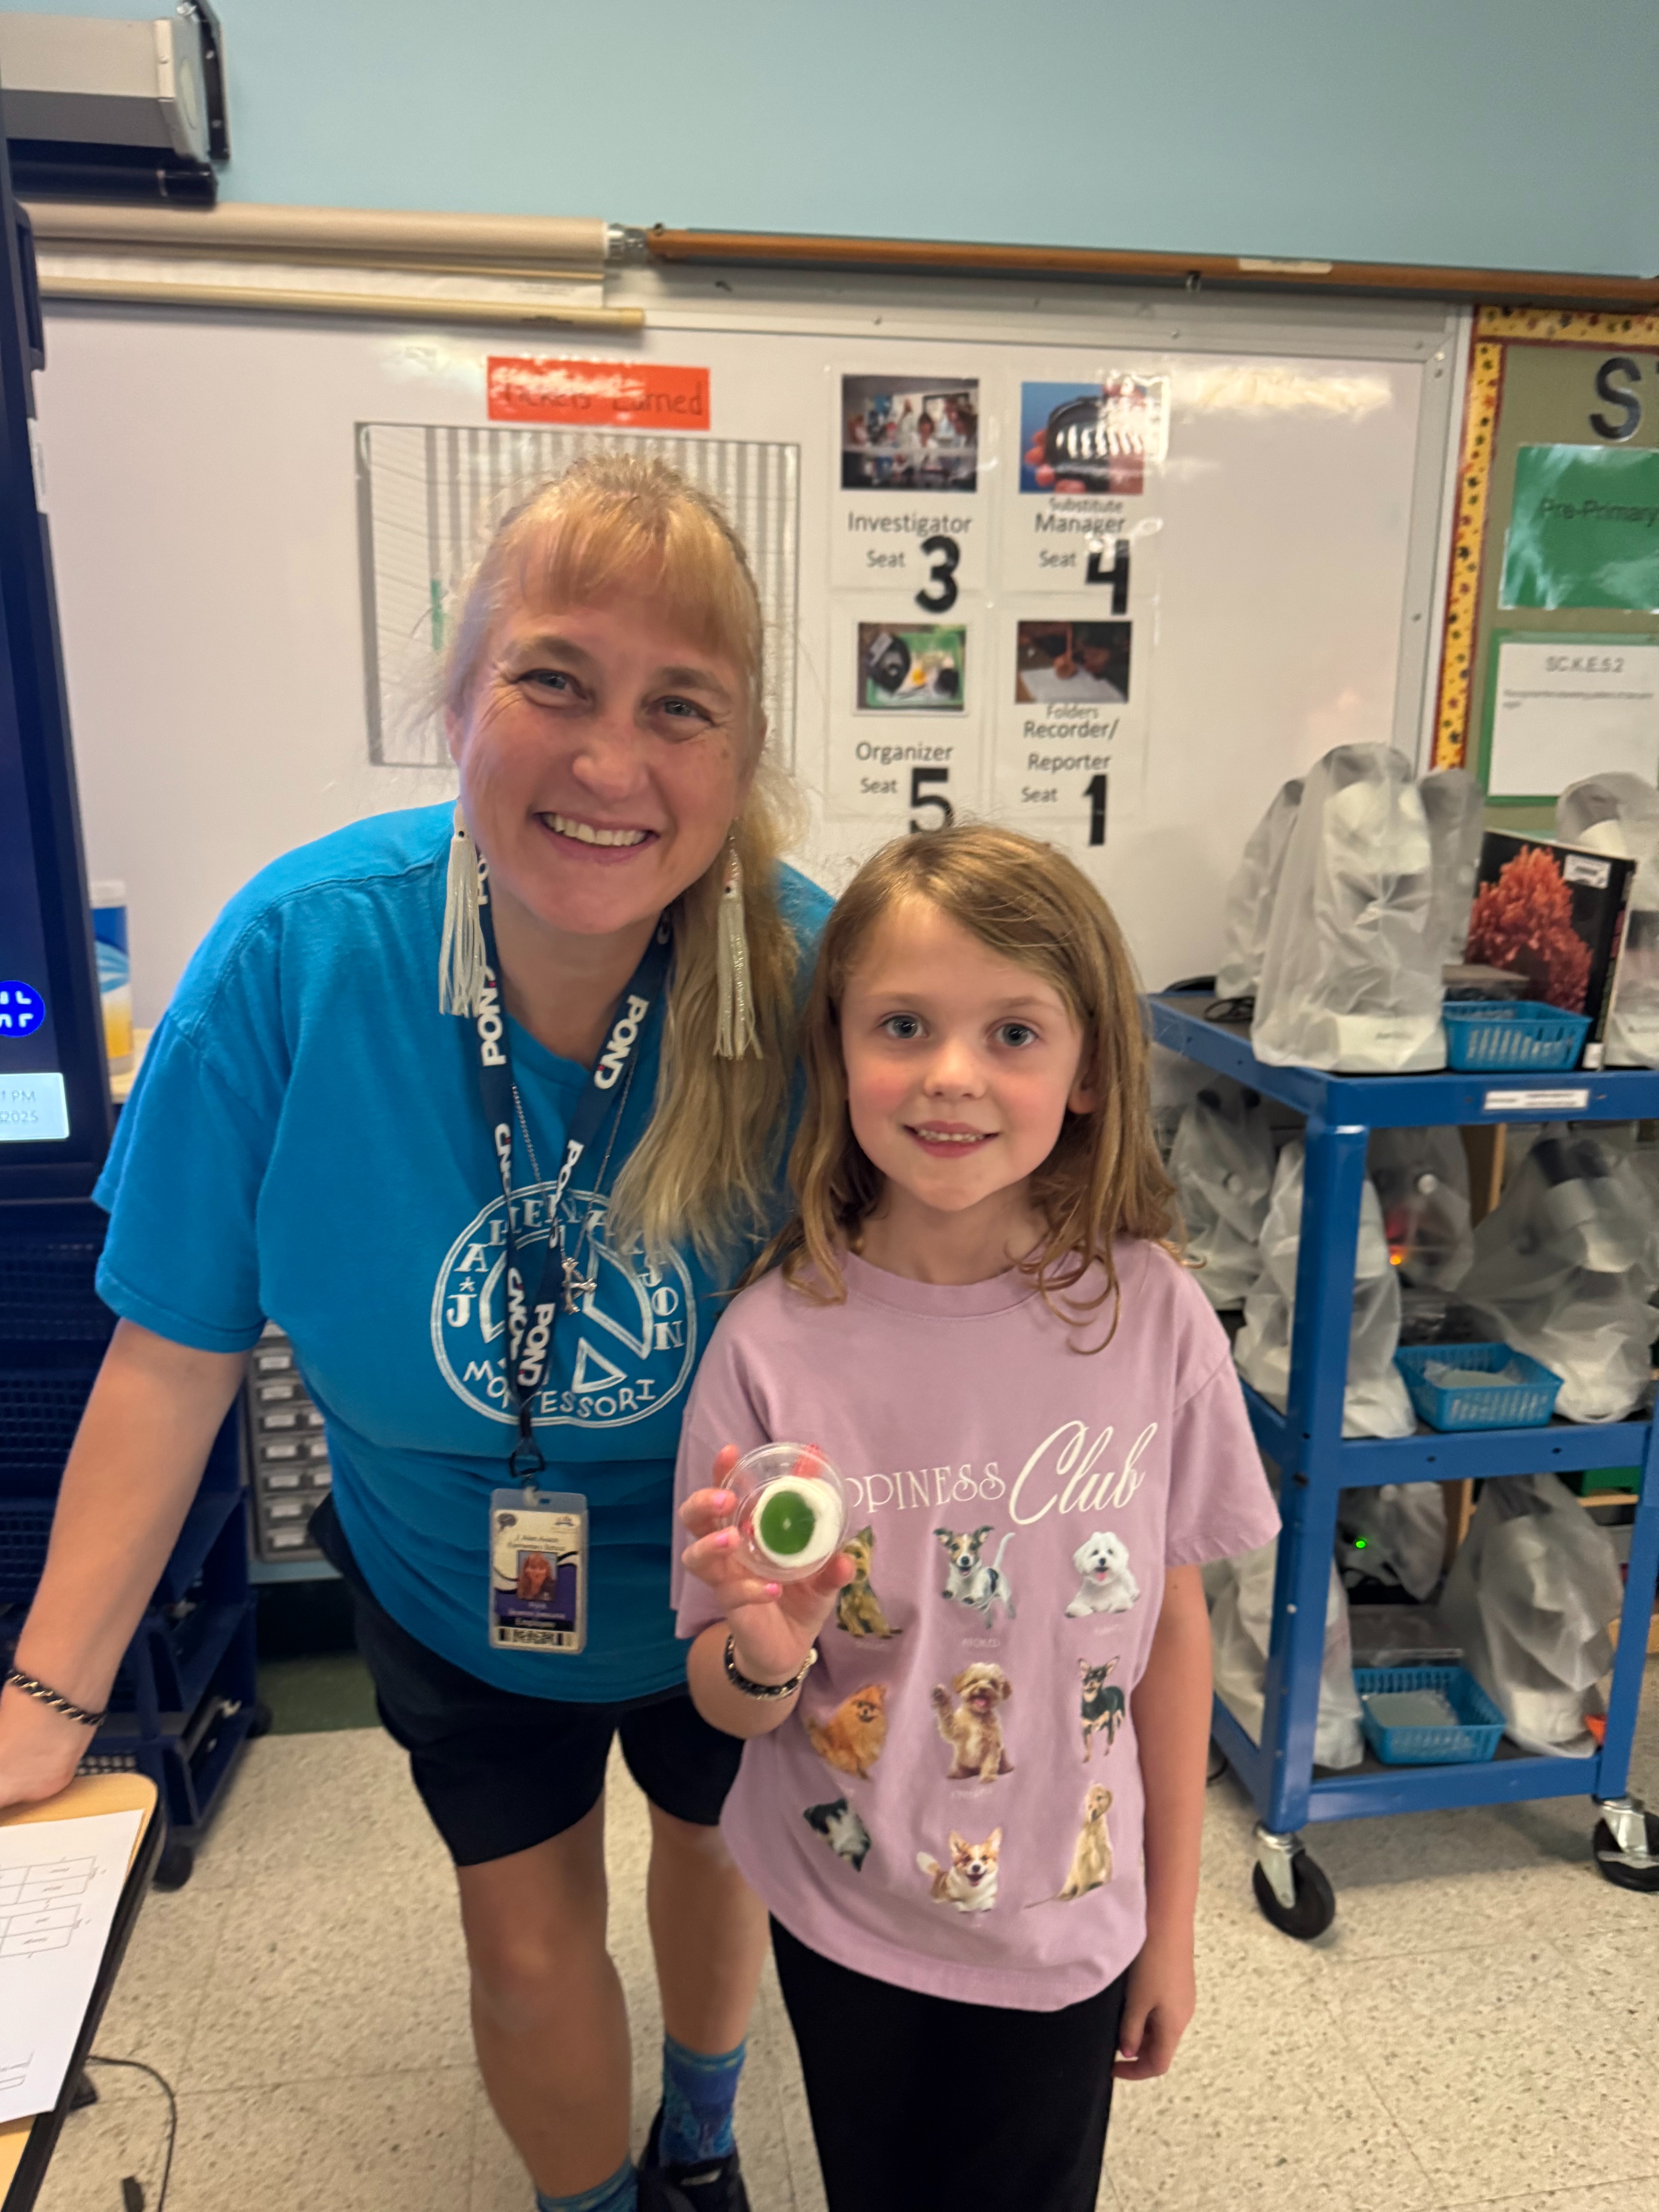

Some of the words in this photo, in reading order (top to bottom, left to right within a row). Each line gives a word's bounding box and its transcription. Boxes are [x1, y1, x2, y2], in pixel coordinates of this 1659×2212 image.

[1589, 356, 1659, 442] S
[848, 511, 972, 536] Investigator
[1034, 513, 1125, 535] Manager
[867, 551, 905, 568] Seat
[914, 535, 960, 613] 3
[1039, 550, 1076, 568] Seat
[1084, 539, 1130, 615] 4
[855, 742, 953, 764] Organizer
[1024, 717, 1120, 740] Recorder/
[1028, 752, 1111, 774] Reporter
[860, 777, 897, 794] Seat
[909, 767, 954, 834] 5
[1021, 786, 1058, 803] Seat
[1083, 774, 1108, 846] 1
[12, 1089, 36, 1103] PM
[518, 1303, 555, 1387] POND
[462, 1360, 656, 1418] MOESSORI
[1009, 1420, 1158, 1525] Club
